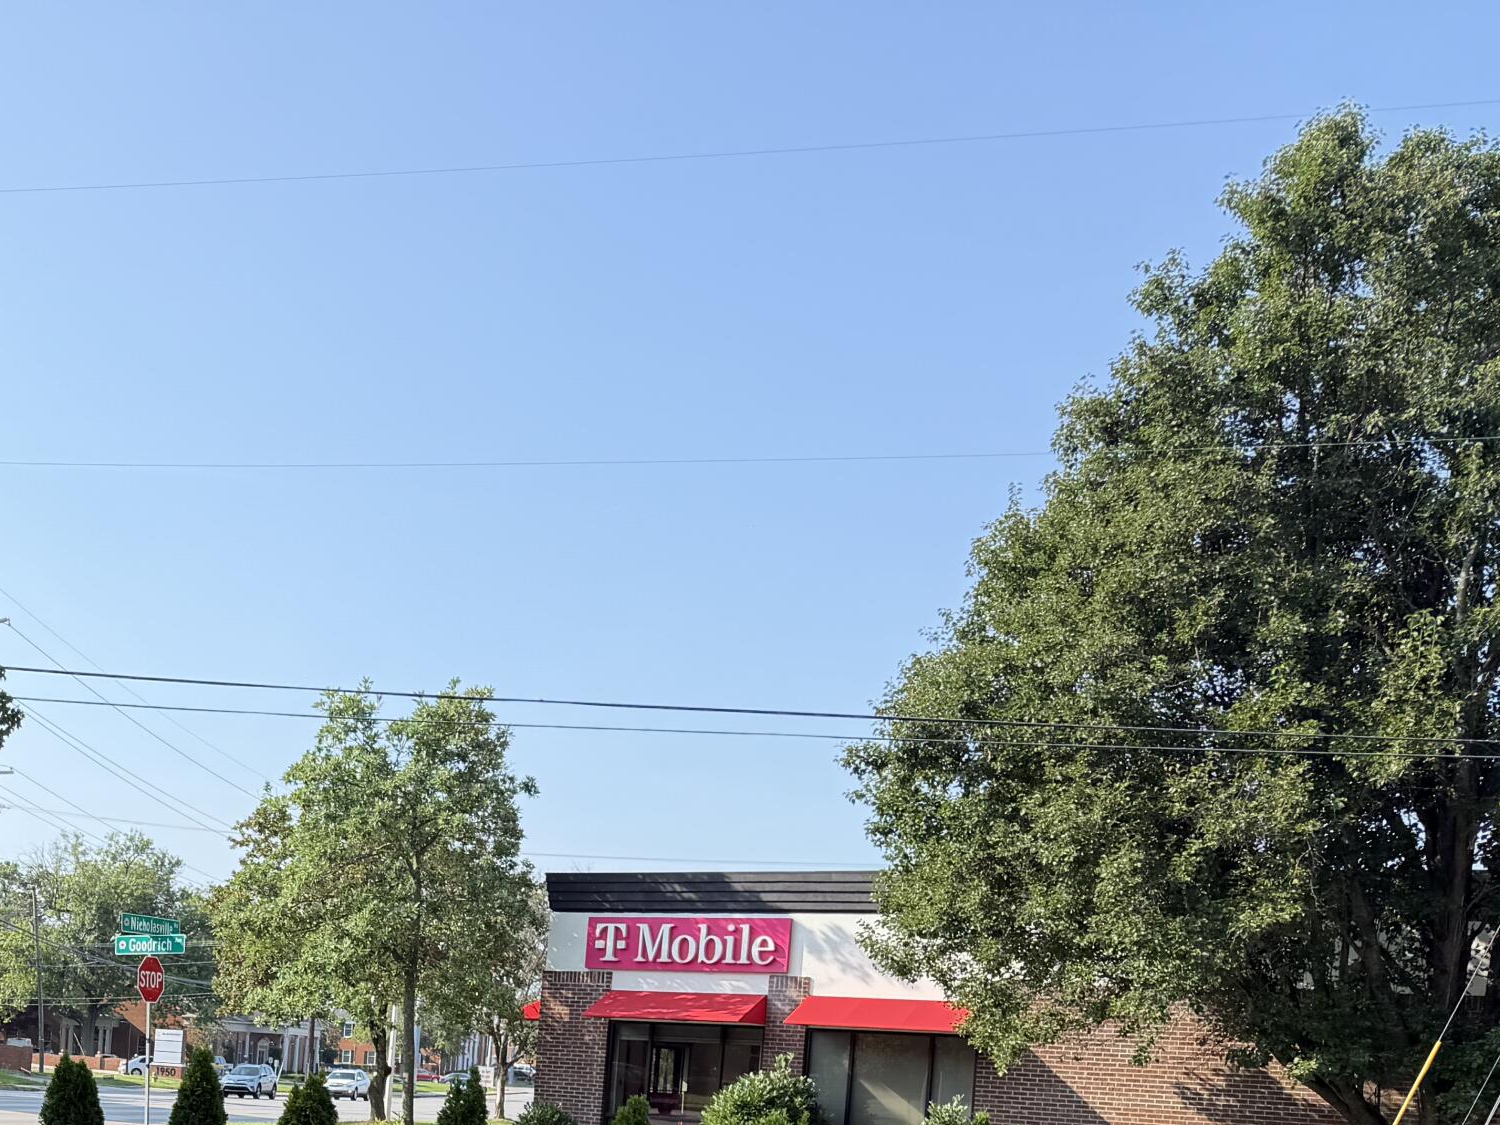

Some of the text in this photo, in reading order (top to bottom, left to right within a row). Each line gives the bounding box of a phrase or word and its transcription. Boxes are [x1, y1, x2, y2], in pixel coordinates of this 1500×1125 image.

[130, 916, 173, 935] Nicholasville
[129, 938, 172, 952] Goodrich
[595, 922, 776, 966] T Mobile
[140, 970, 163, 988] STOP
[156, 1067, 176, 1077] 1950
